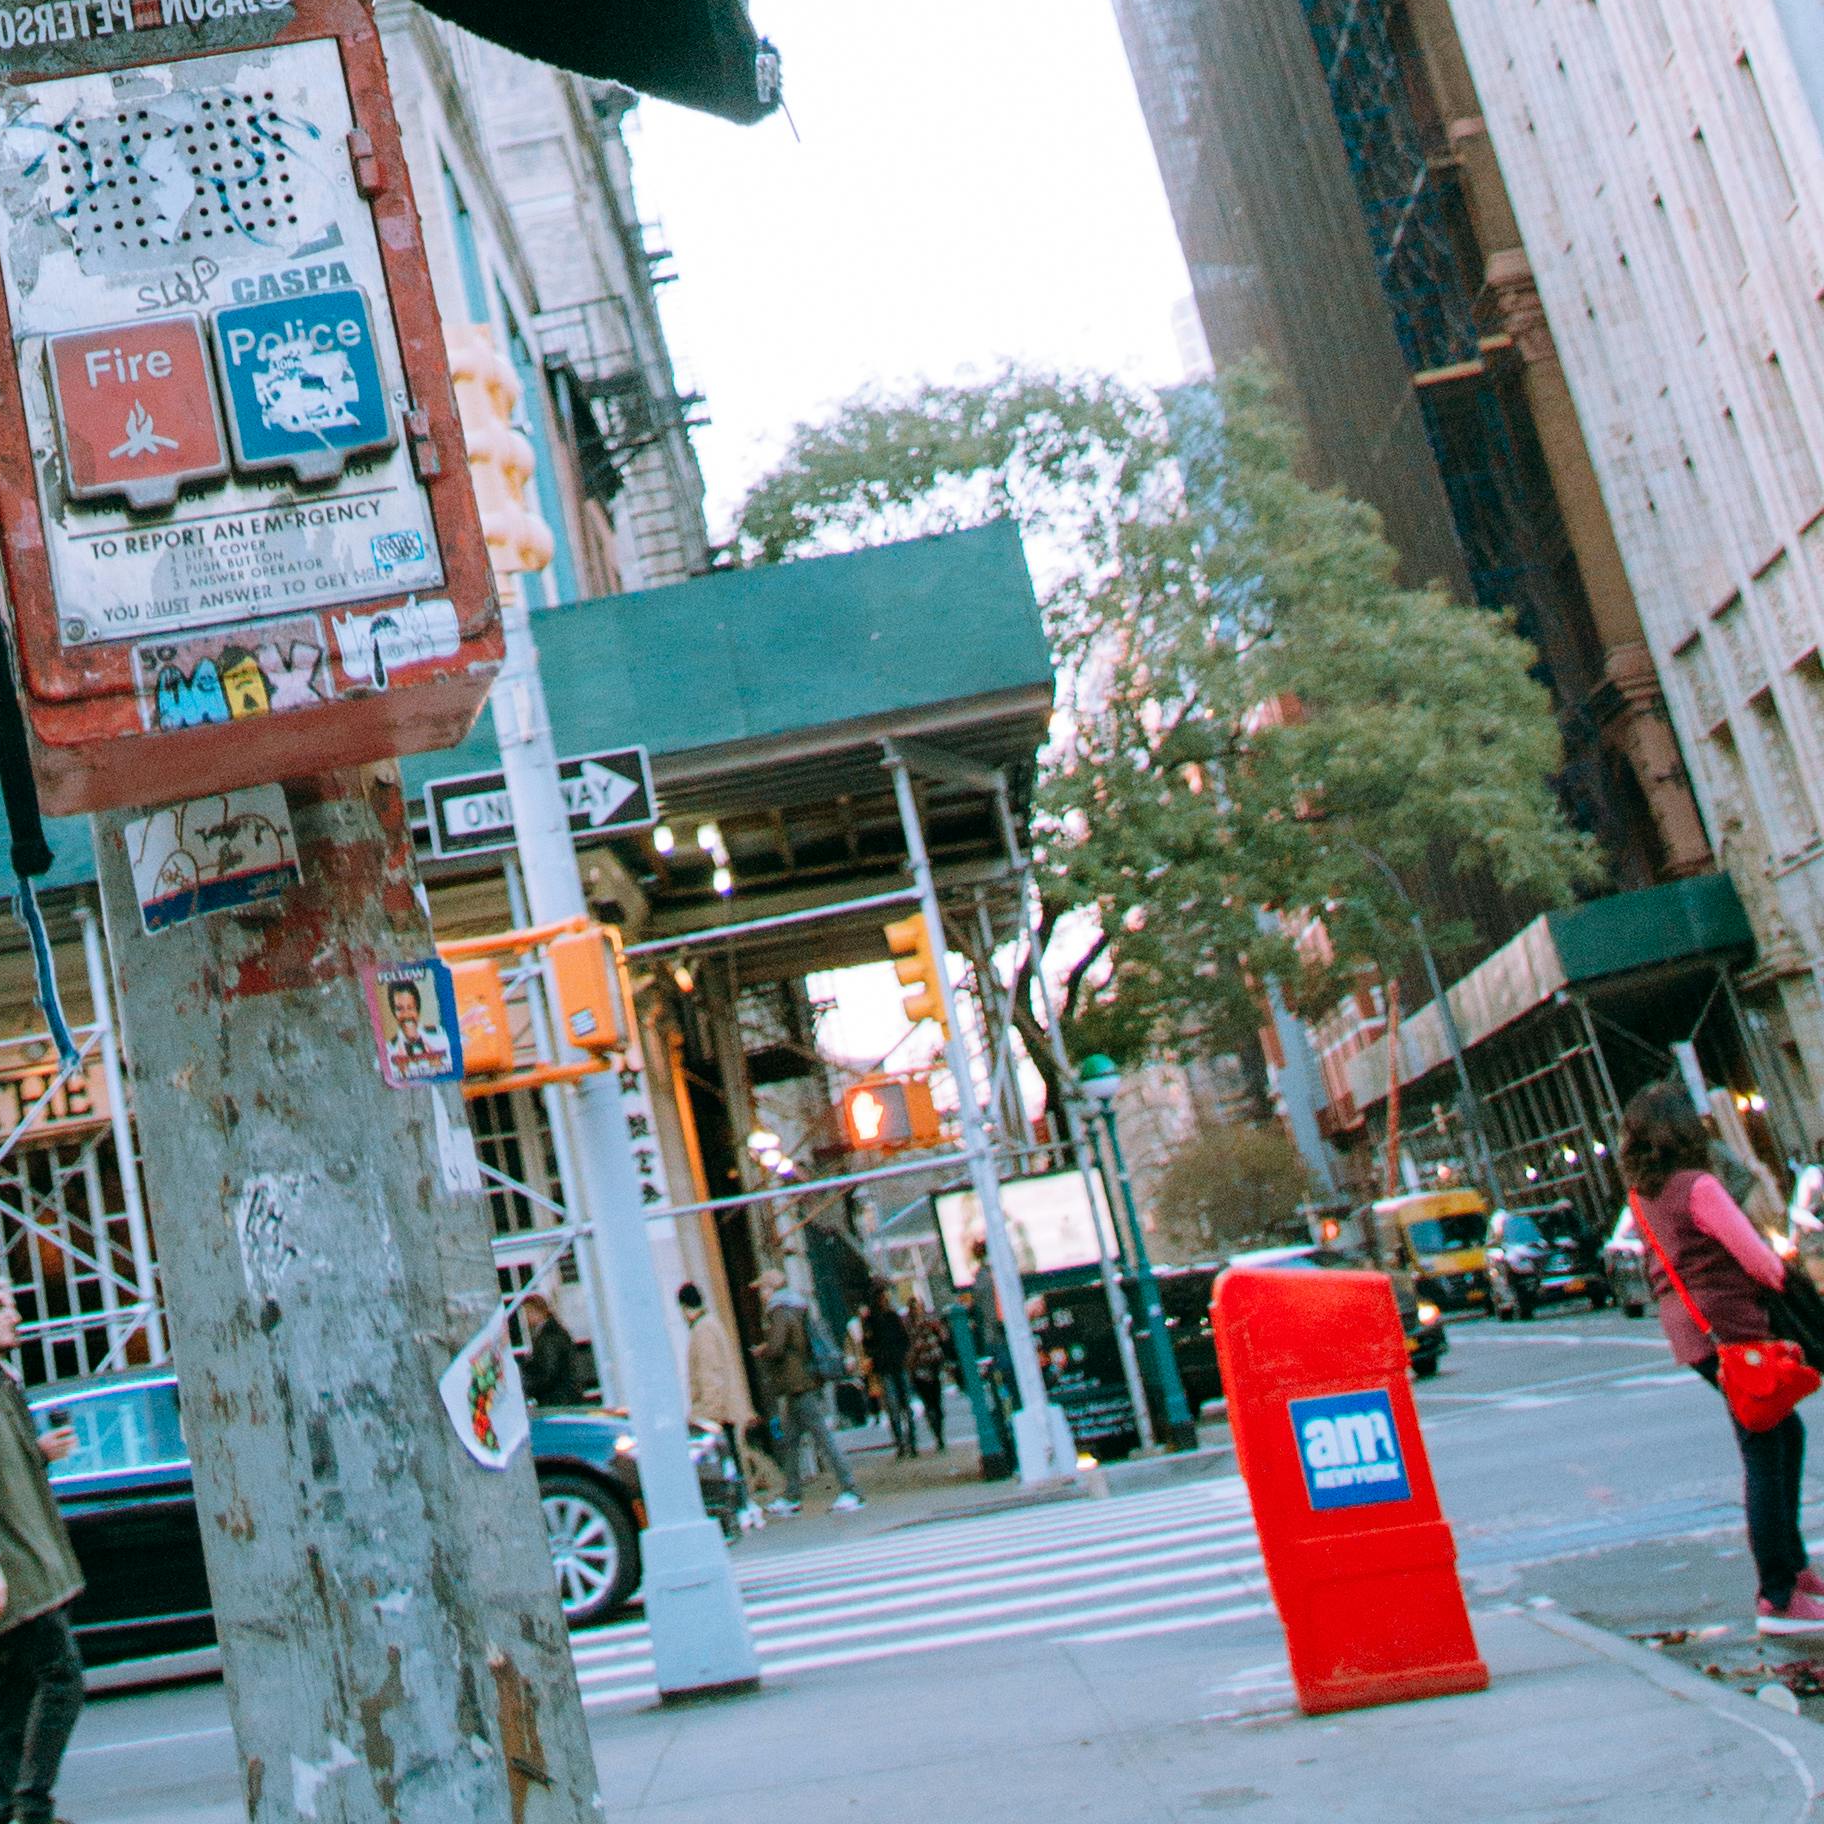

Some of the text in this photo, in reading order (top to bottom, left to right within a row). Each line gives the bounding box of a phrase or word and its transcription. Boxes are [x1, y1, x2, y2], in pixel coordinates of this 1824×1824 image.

[227, 318, 362, 366] Police
[84, 346, 173, 389] Fire
[90, 499, 382, 560] TO REPORT AN EMERGENCY
[184, 546, 214, 560] LIFT
[219, 539, 267, 556] COVER
[185, 561, 220, 575] PUSH
[227, 551, 284, 569] BUTTON
[188, 571, 245, 588] ANSWER
[251, 558, 324, 579] OPERATOR
[103, 604, 139, 622] YOU
[199, 586, 273, 609] ANSWER
[281, 579, 306, 596] TO
[463, 791, 513, 827] ON
